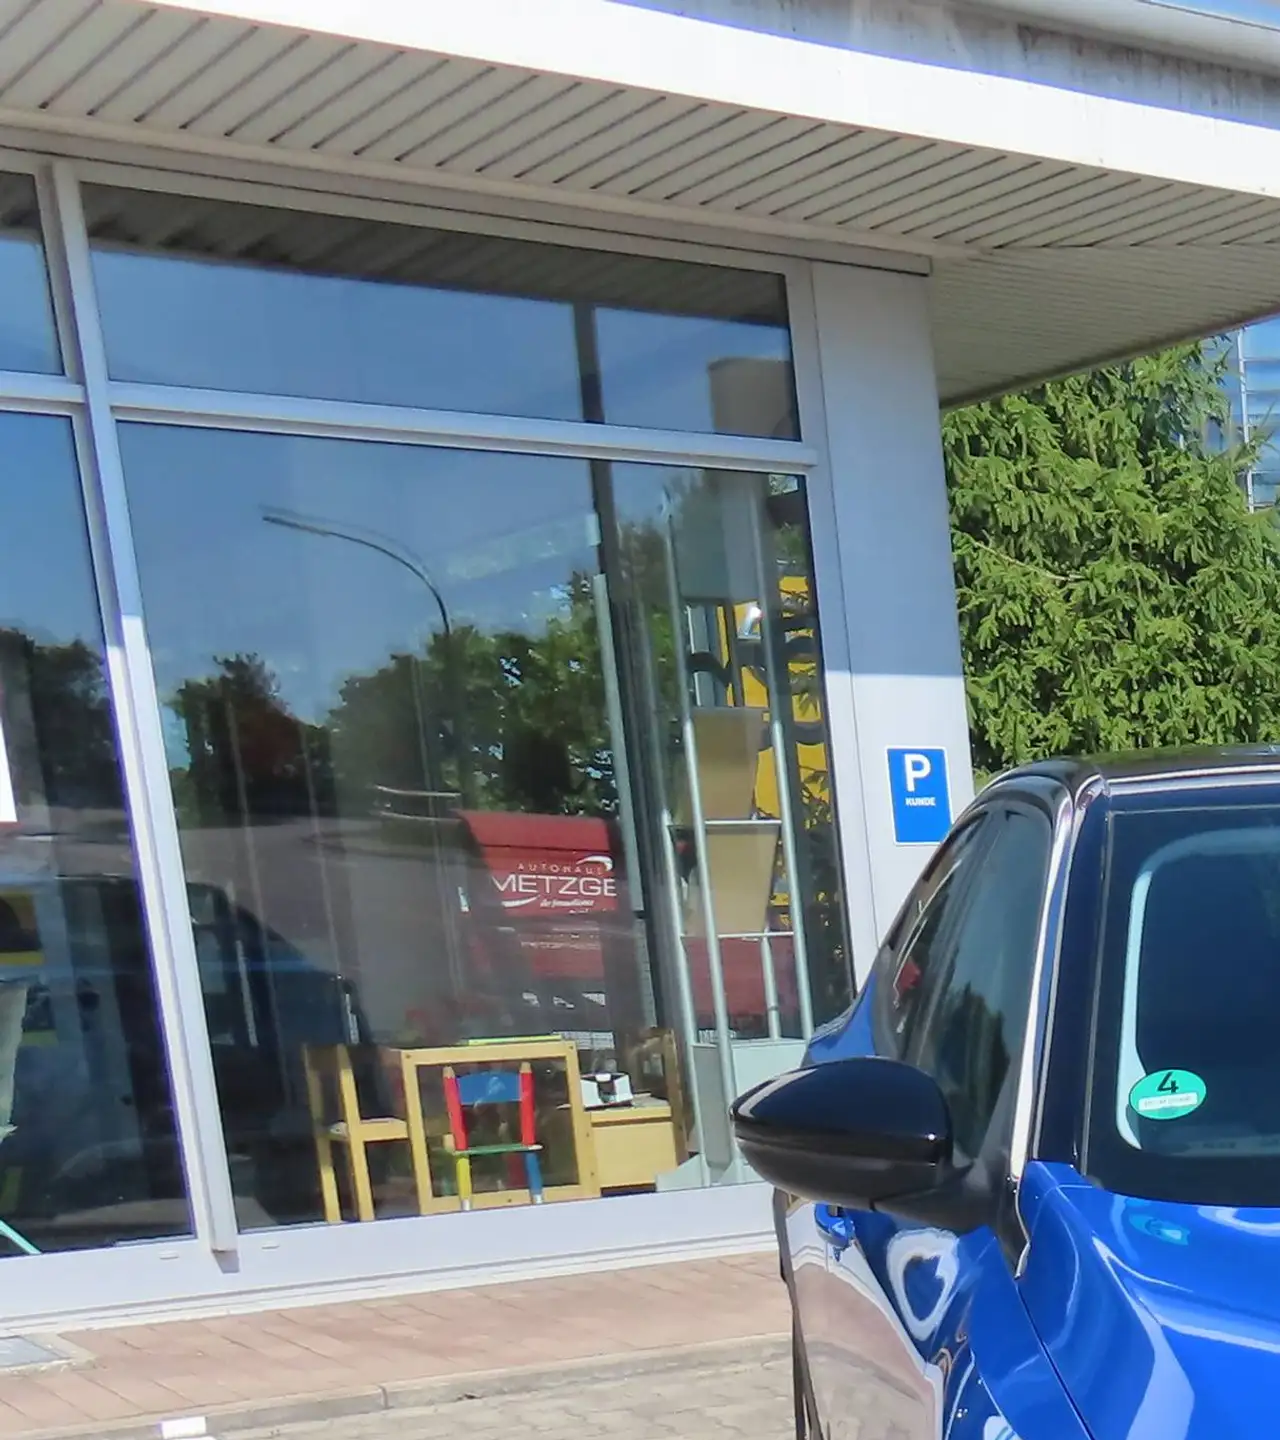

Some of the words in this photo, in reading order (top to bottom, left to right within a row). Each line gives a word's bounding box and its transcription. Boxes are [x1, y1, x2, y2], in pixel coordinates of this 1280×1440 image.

[904, 753, 931, 792] P
[491, 874, 618, 897] METZGE
[1157, 1071, 1179, 1094] 4
